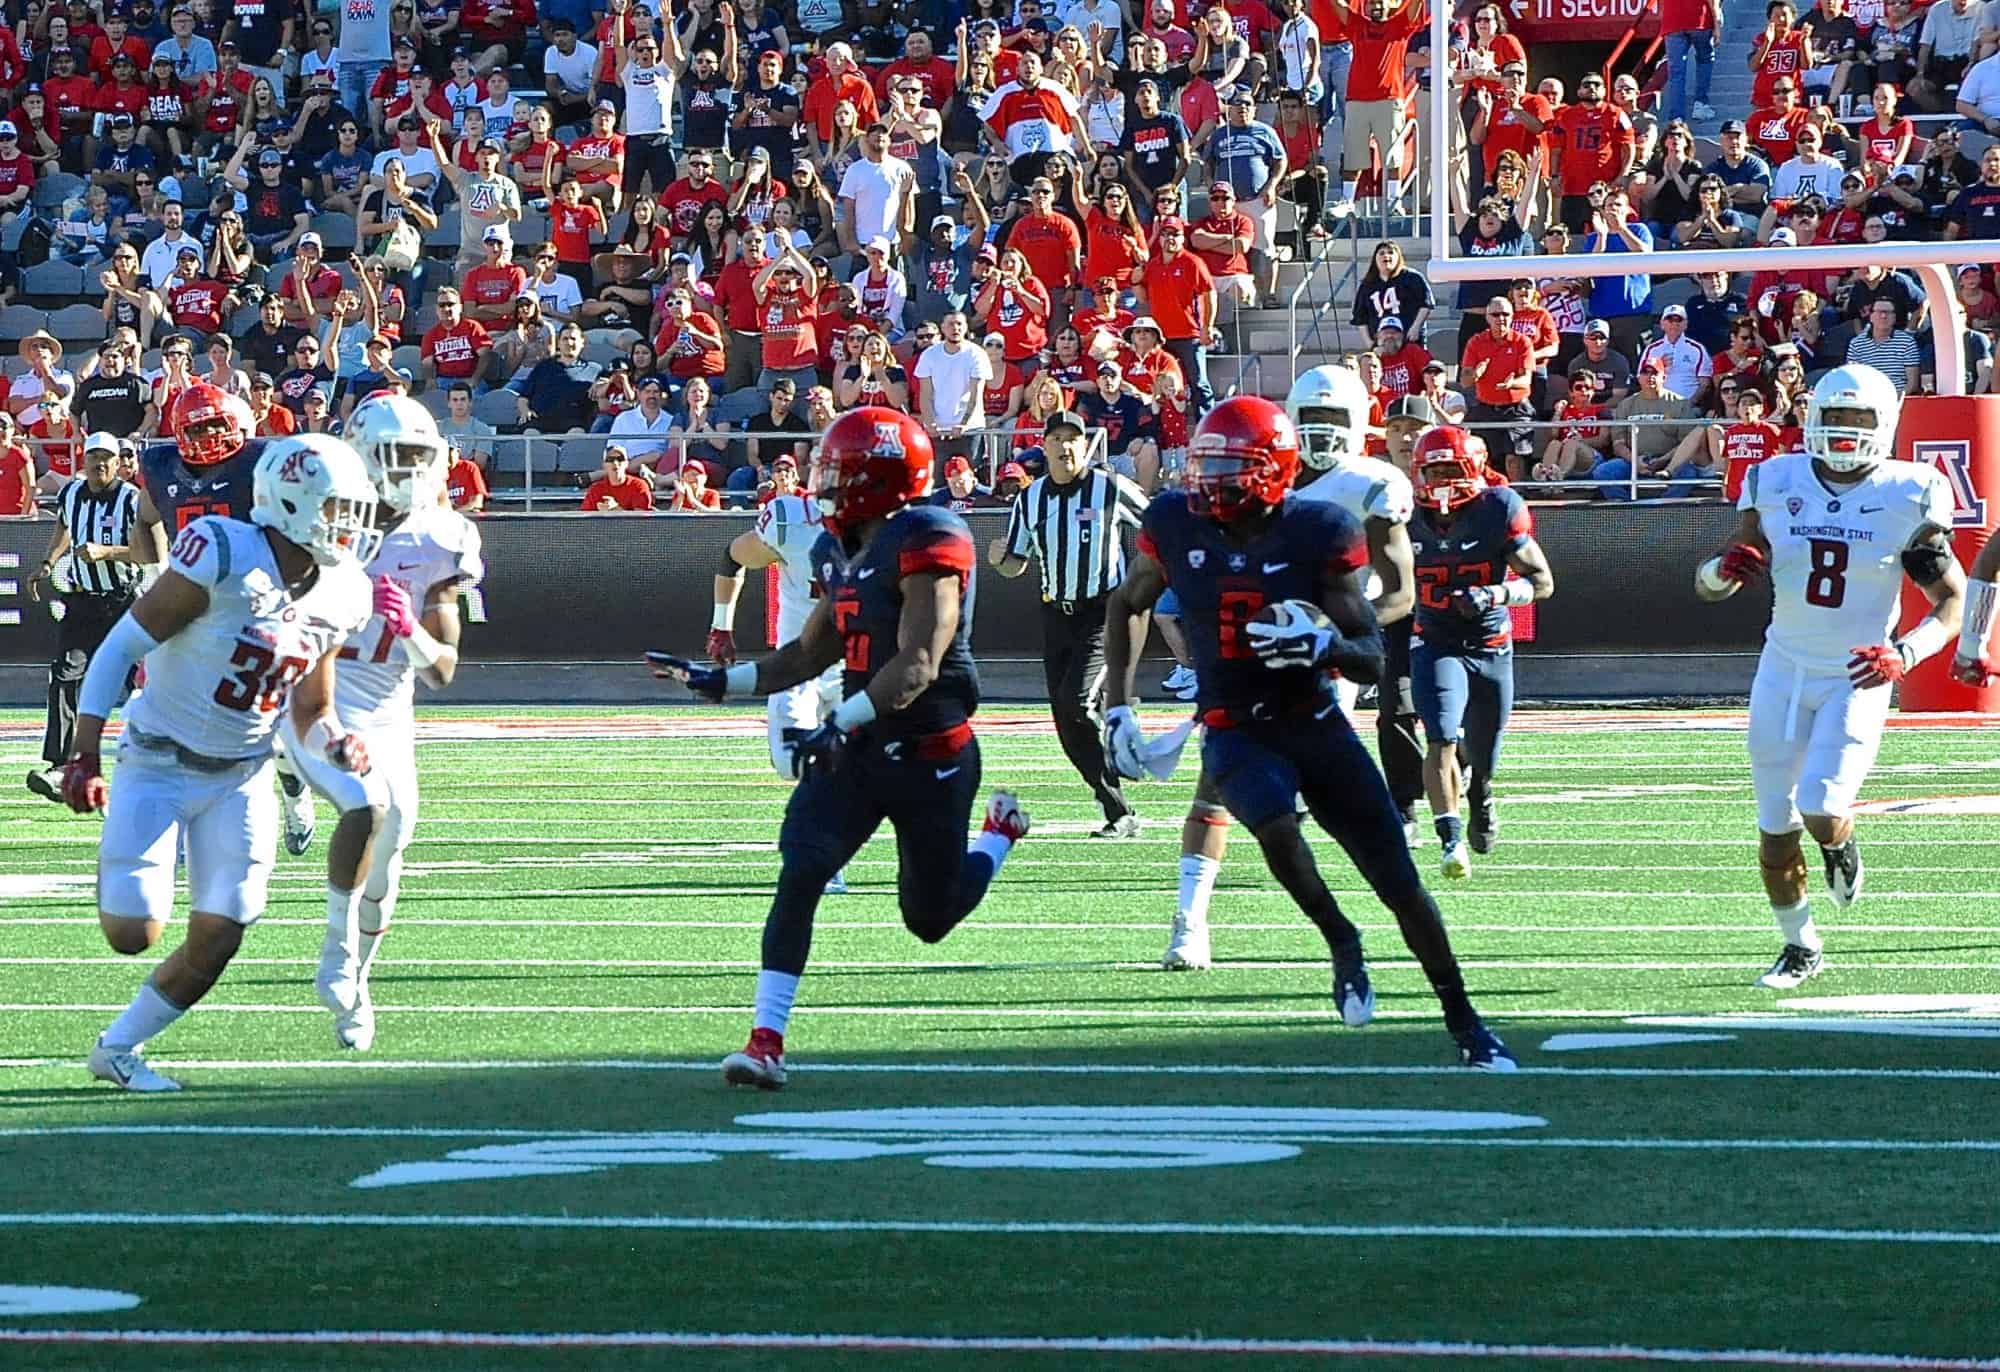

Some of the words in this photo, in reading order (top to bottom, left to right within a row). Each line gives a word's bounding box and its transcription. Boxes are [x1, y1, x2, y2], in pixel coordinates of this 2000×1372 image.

[1767, 50, 1796, 73] 33
[1135, 128, 1166, 141] BEAR
[1368, 286, 1401, 318] 14
[434, 337, 471, 353] ARIZONA
[86, 388, 127, 400] ARIZONA
[871, 421, 906, 459] A
[1789, 525, 1845, 539] WASHINGTON
[1848, 529, 1873, 542] STATE
[171, 528, 208, 568] 30
[1805, 537, 1850, 609] 8
